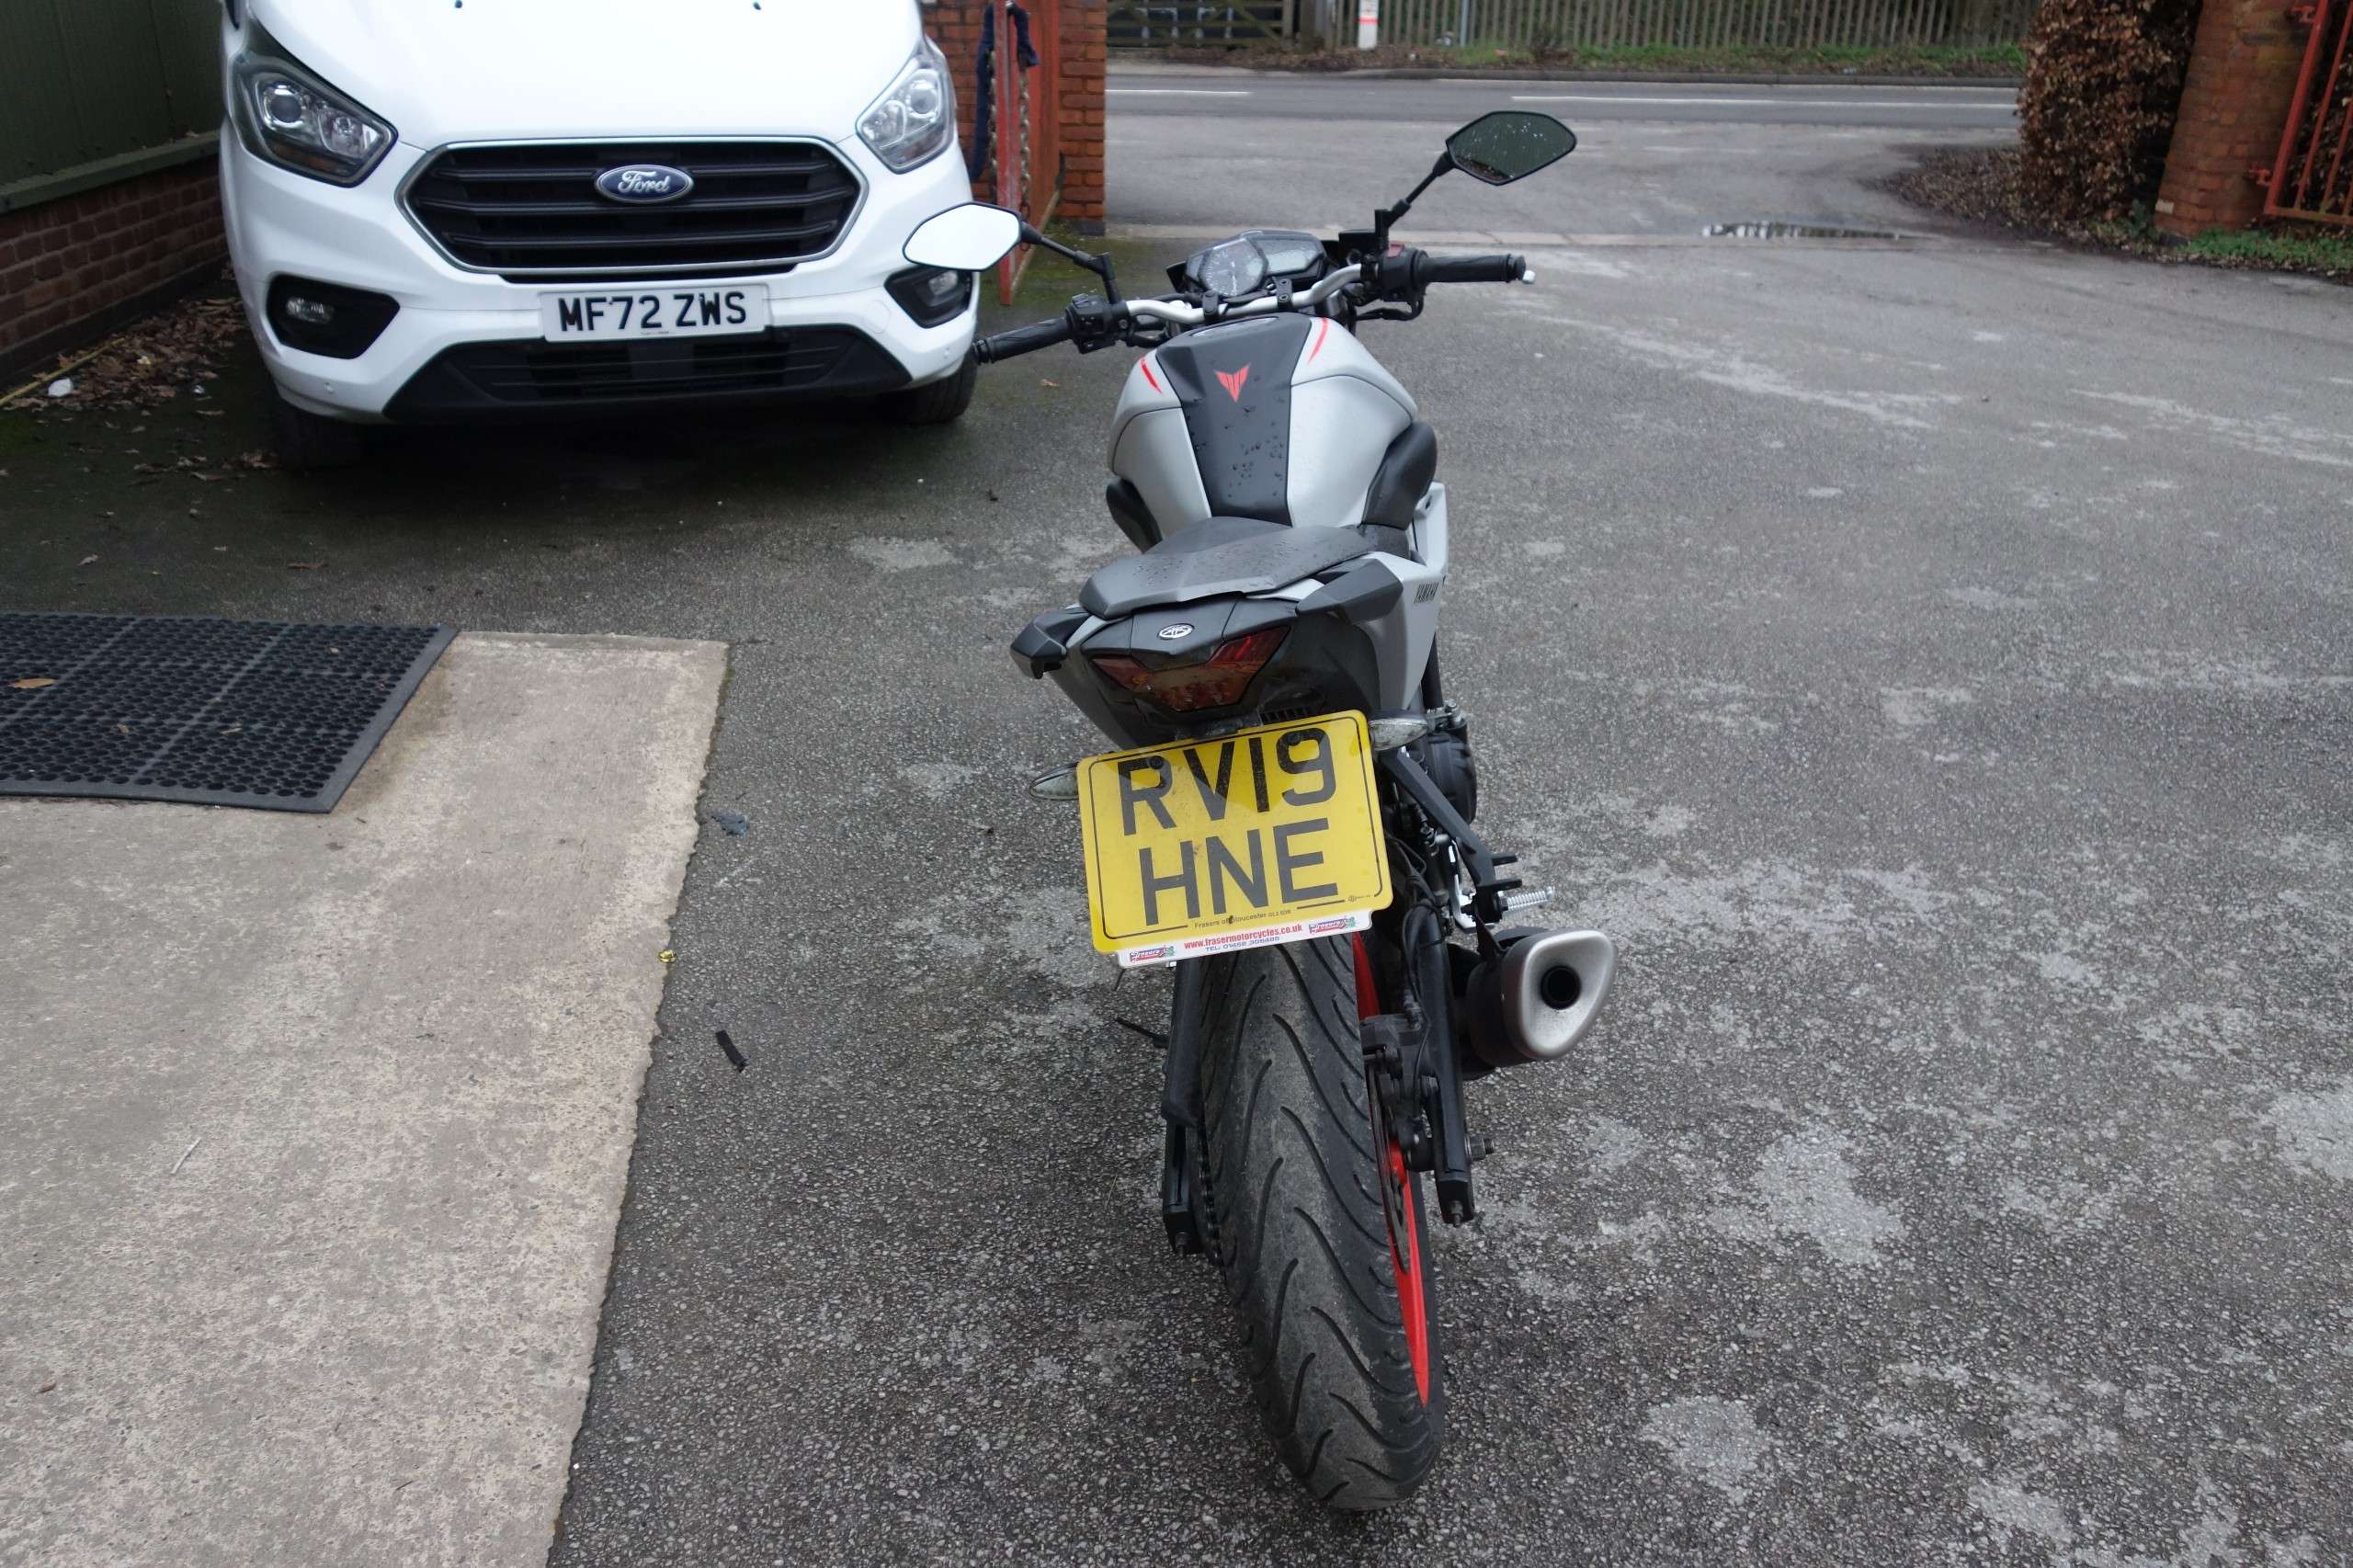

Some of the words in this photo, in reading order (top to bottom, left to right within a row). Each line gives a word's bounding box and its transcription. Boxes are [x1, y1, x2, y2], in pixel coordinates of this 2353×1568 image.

[618, 170, 671, 193] Ford
[558, 295, 662, 332] MF72
[673, 291, 747, 327] ZWS
[1117, 727, 1337, 836] RV19
[1139, 817, 1339, 926] HNE
[1184, 924, 1302, 949] www.frasermotorcycles.co.uk
